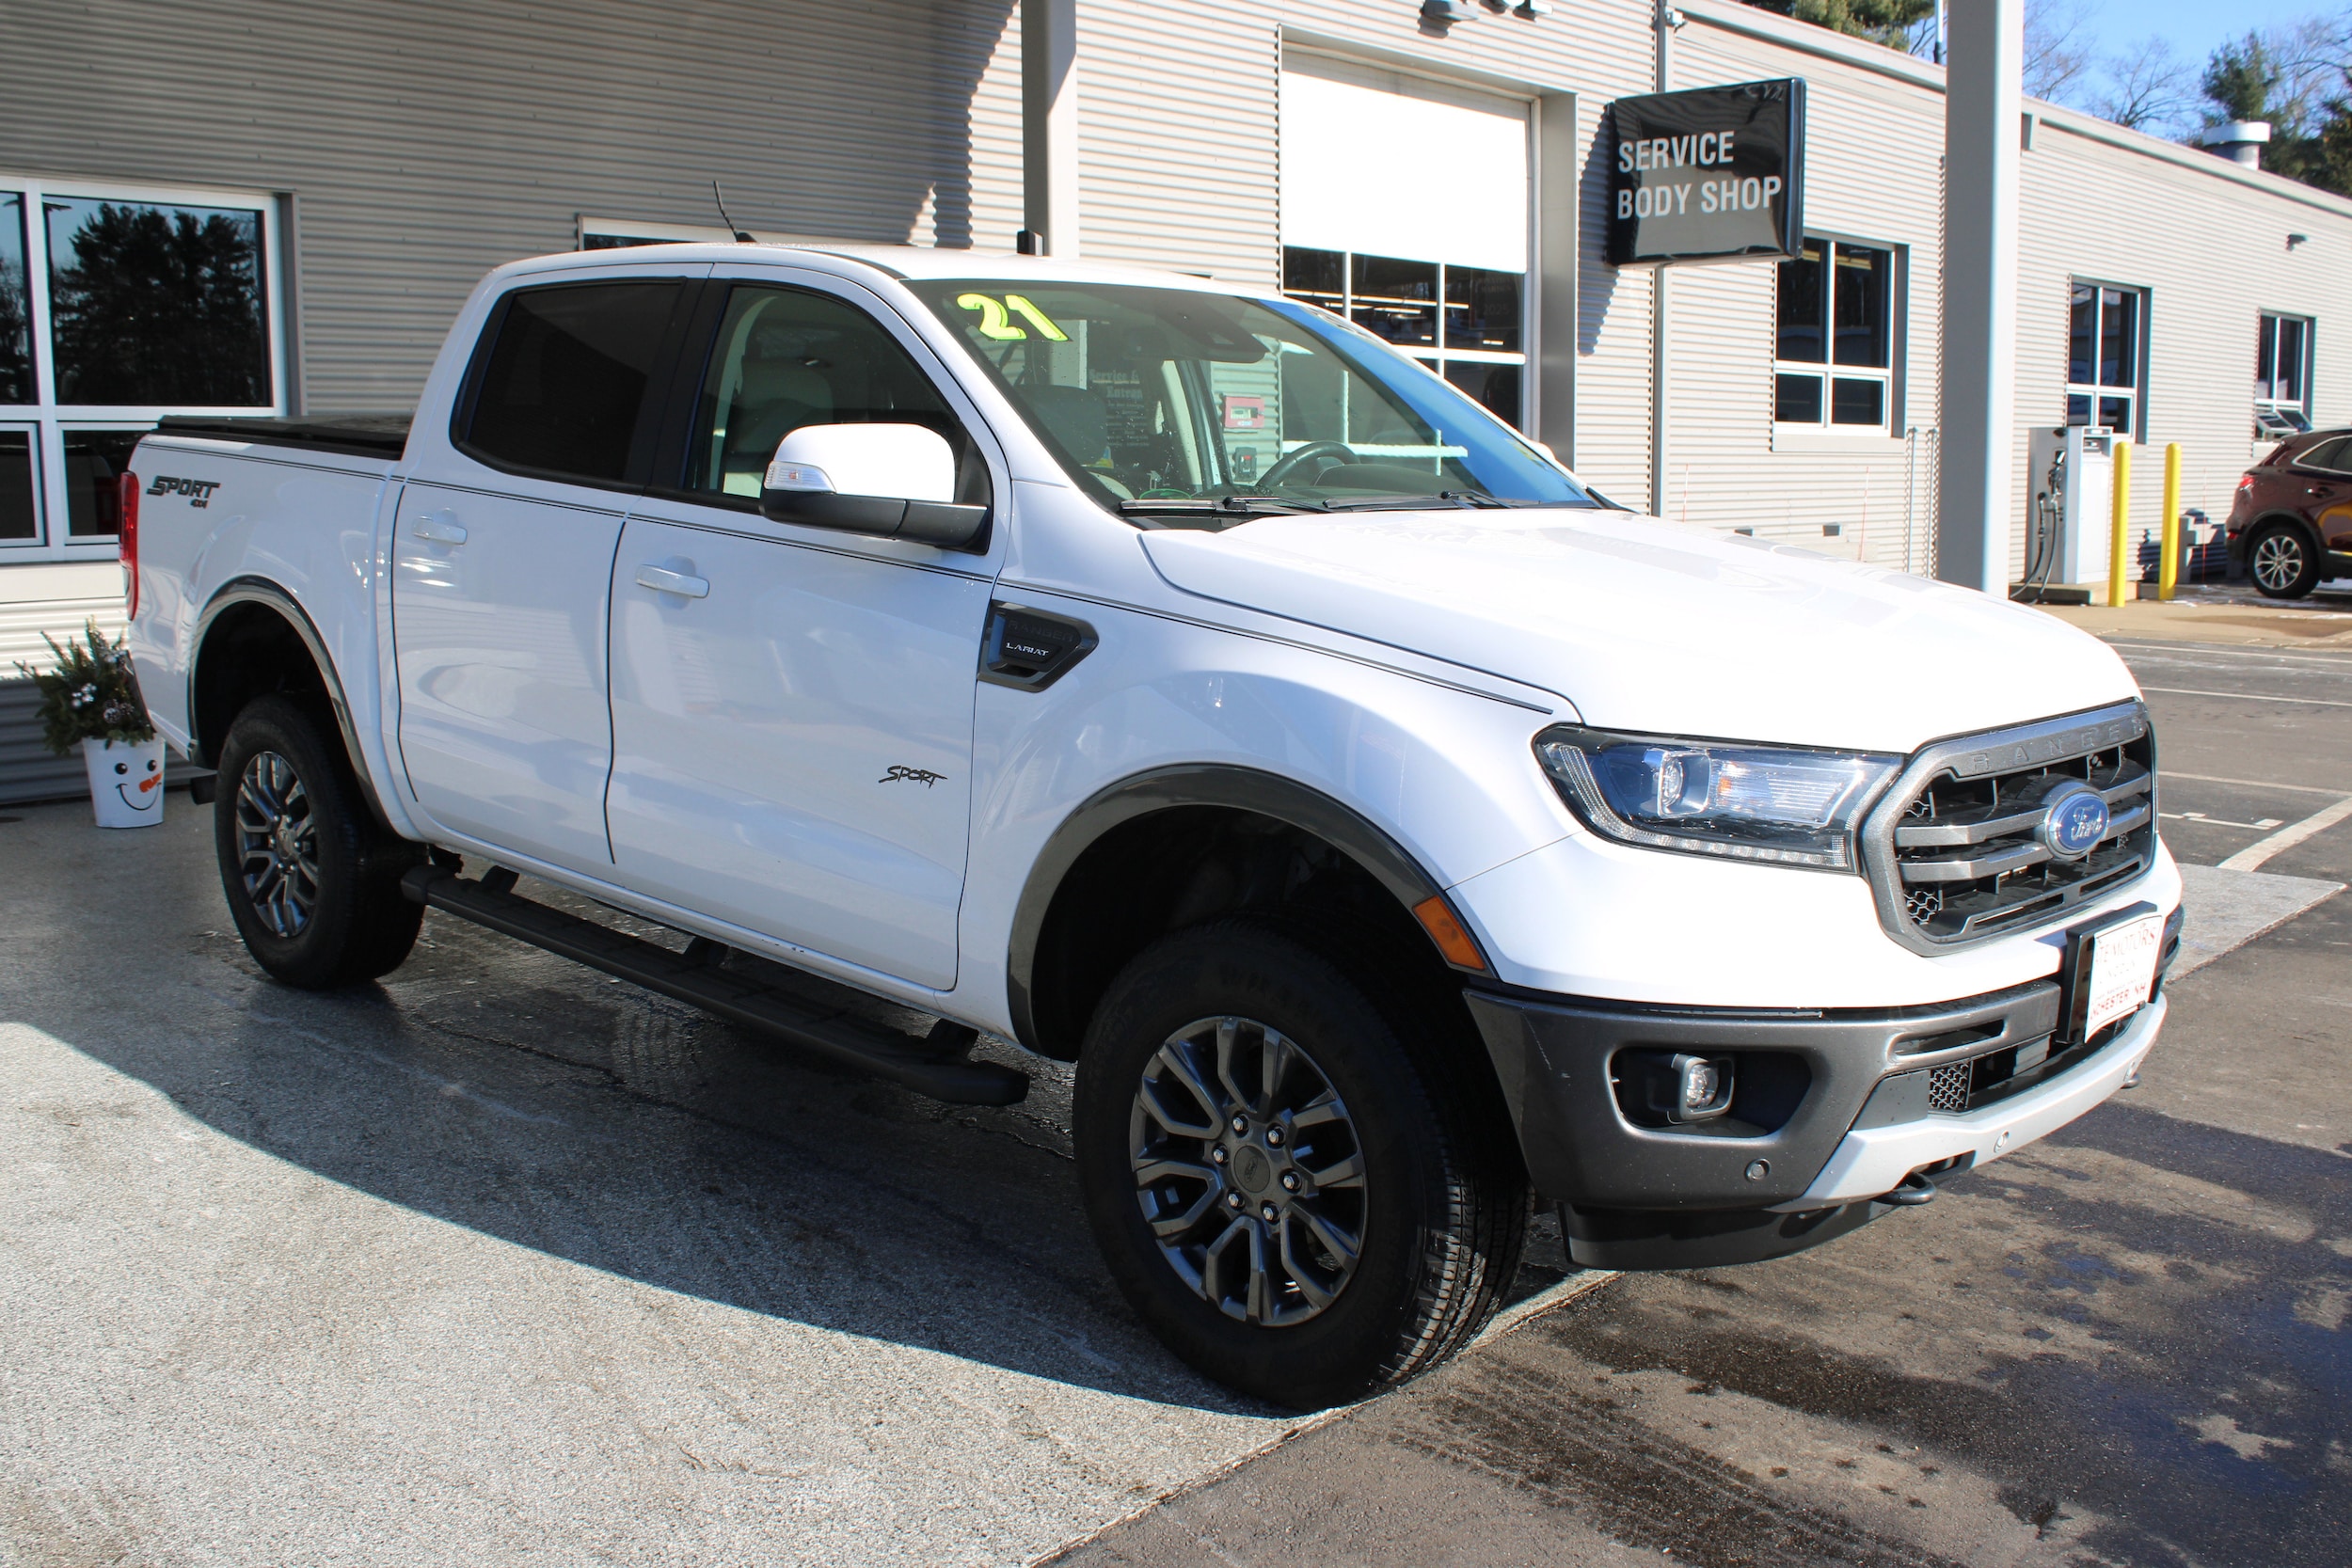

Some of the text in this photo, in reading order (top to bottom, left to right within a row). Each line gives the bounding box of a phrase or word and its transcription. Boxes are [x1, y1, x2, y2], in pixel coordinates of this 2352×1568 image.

[1618, 131, 1735, 173] SERVICE
[1617, 176, 1782, 219] BODY SHOP
[957, 293, 1070, 341] 21
[146, 475, 221, 499] SPORT
[1006, 641, 1049, 657] LARIAT
[1972, 720, 2143, 770] RANGER
[879, 765, 947, 788] SPORT
[2071, 804, 2104, 841] Ford
[2112, 927, 2156, 956] MOTORS
[2135, 983, 2147, 994] NH
